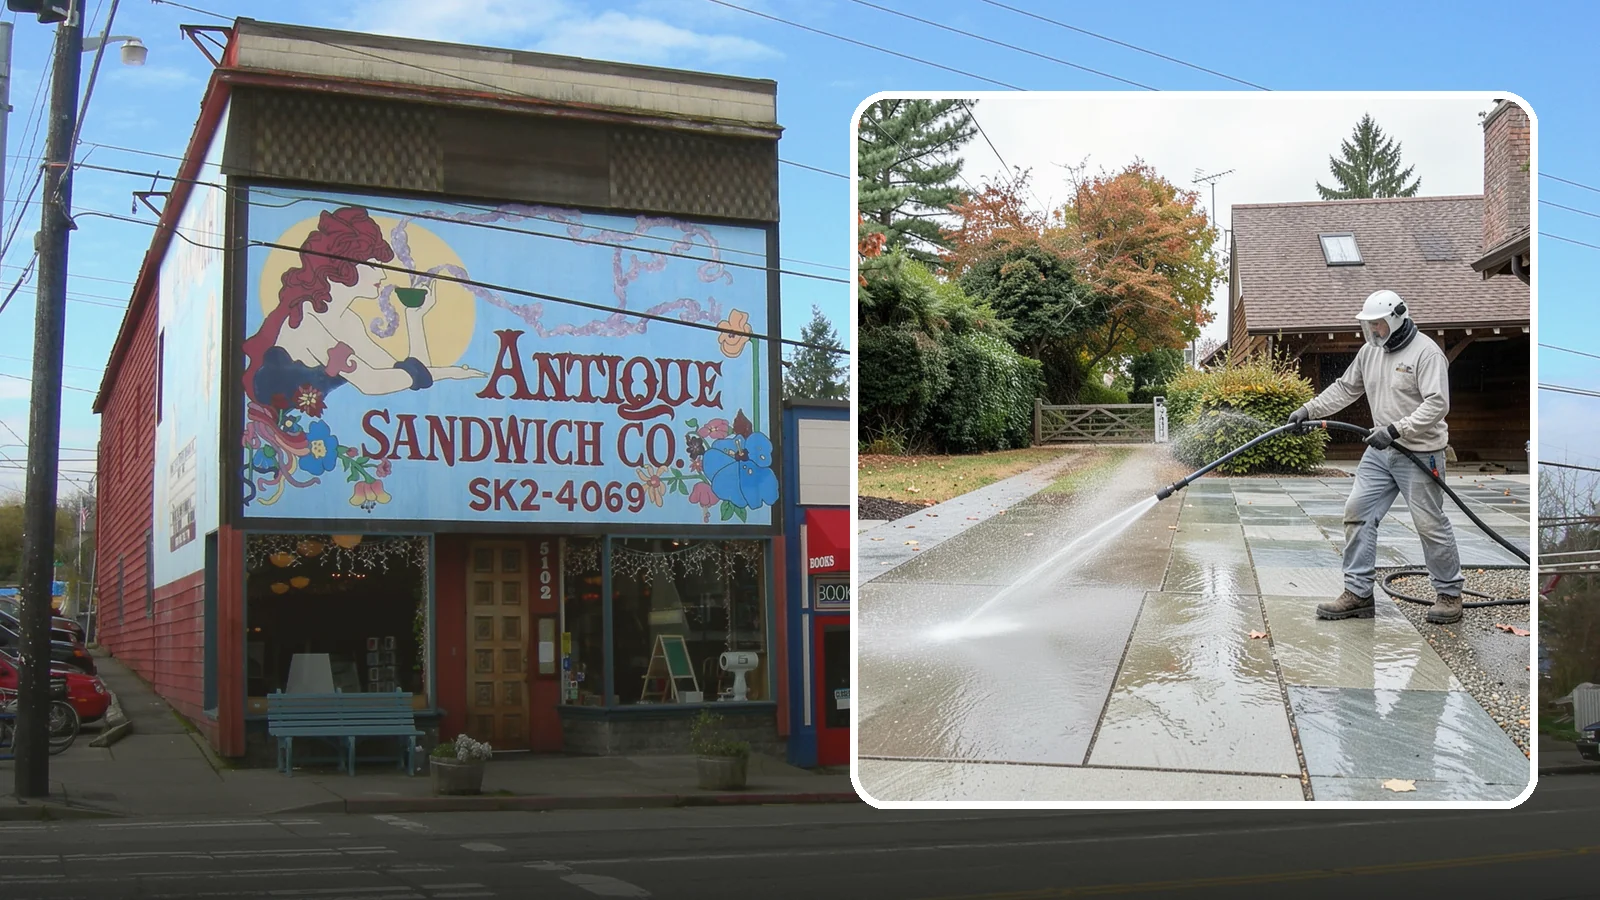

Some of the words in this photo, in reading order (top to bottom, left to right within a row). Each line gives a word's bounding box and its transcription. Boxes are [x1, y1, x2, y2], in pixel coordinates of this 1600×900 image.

[476, 329, 724, 421] ANTIQUE
[361, 408, 604, 468] SANDWICH
[617, 422, 684, 468] CO.
[468, 477, 646, 513] SK2-4069
[540, 542, 552, 600] 5102
[809, 555, 834, 569] BOOKS
